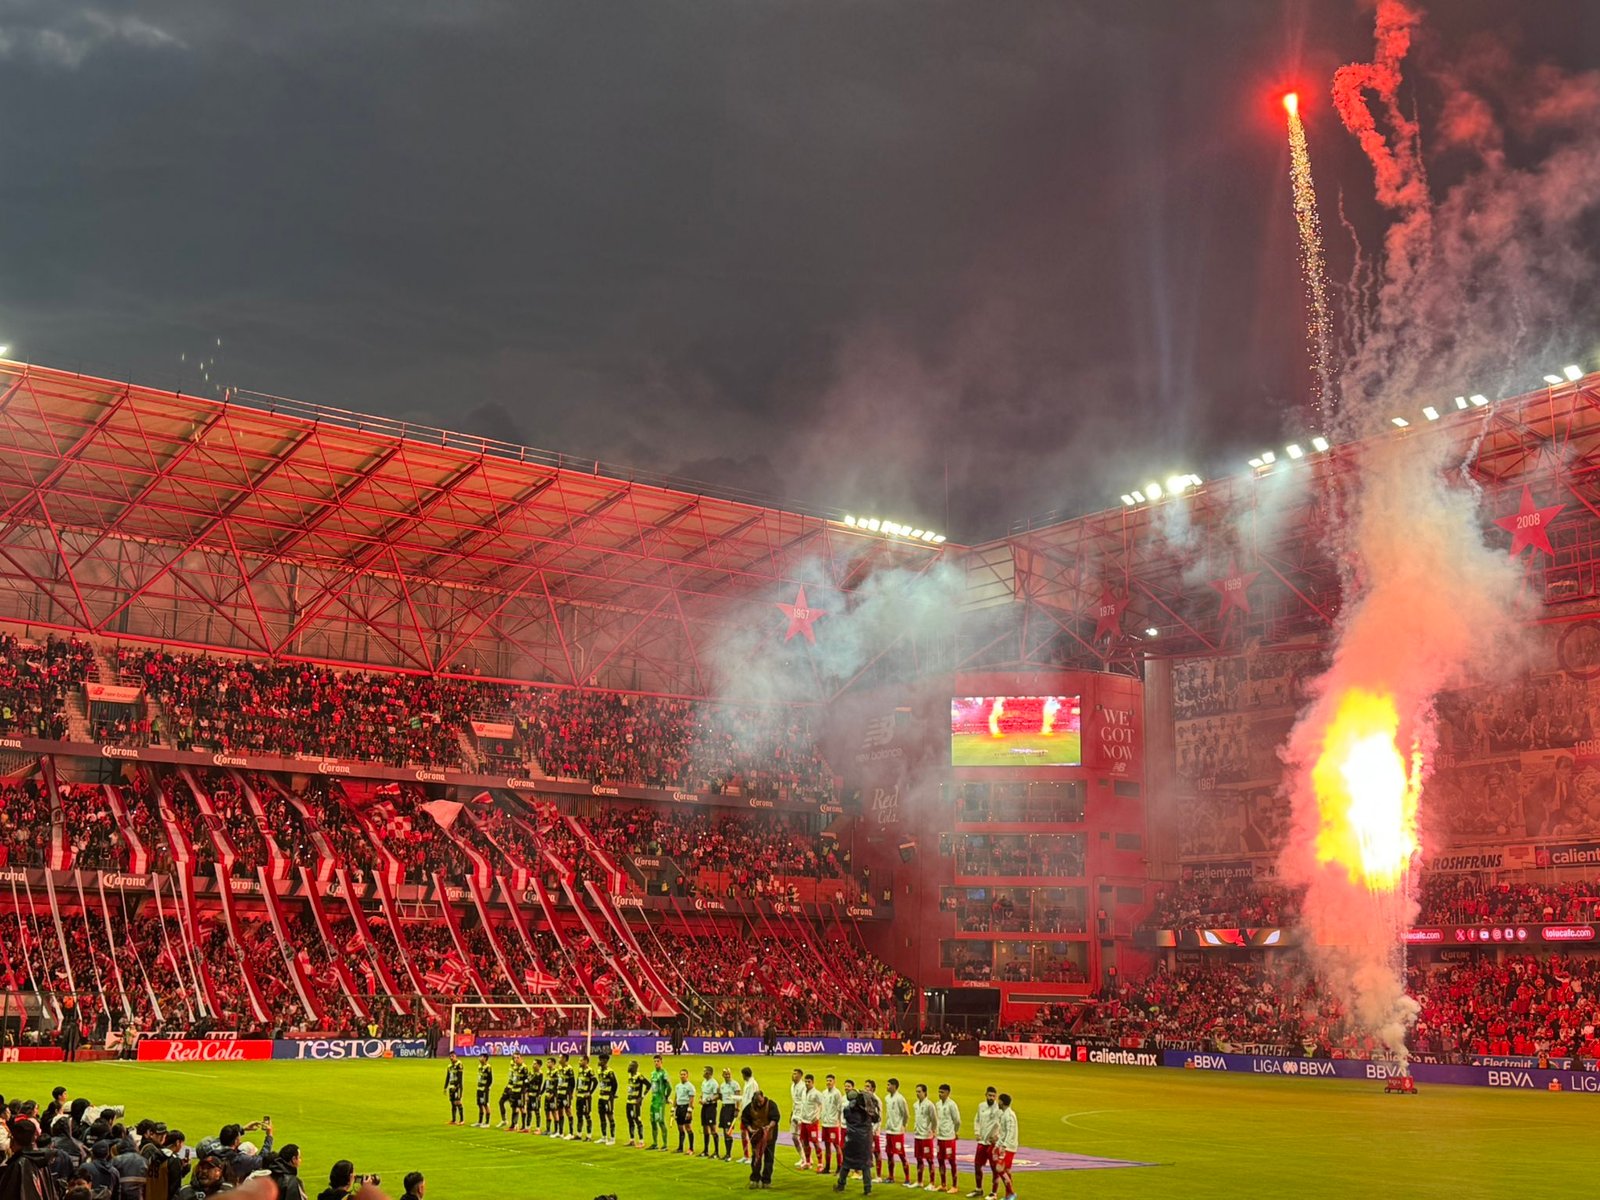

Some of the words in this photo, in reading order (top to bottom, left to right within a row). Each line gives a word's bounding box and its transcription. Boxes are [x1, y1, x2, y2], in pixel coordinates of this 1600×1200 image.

[1516, 512, 1541, 529] 2008
[1103, 708, 1130, 726] WE
[1100, 726, 1135, 744] GOT
[101, 744, 139, 758] Corona
[1102, 744, 1135, 760] NOW
[1574, 739, 1600, 756] 1998
[213, 753, 247, 766] Corona
[318, 762, 351, 774] Corona
[415, 770, 446, 781] Corona
[506, 777, 535, 789] Corona
[592, 784, 619, 795] Corona
[673, 791, 698, 802] Corona
[749, 798, 774, 808] Corona
[871, 784, 899, 810] Red
[820, 803, 843, 813] Corona
[634, 855, 660, 867] Corona
[1432, 854, 1503, 871] ROSHFRANS
[1193, 866, 1252, 880] caliente.mx
[103, 873, 147, 888] Corona
[846, 906, 873, 917] Corona
[1545, 926, 1592, 938] tolucafc.com
[165, 1040, 203, 1061] Red
[203, 1041, 247, 1061] Cola
[550, 1041, 579, 1054] LIGA
[655, 1041, 690, 1053] BBA
[702, 1041, 735, 1053] BBVA
[796, 1042, 825, 1053] BBVA
[846, 1043, 875, 1054] BBVA
[1089, 1050, 1158, 1067] caliente.mx
[1194, 1054, 1228, 1071] BBVA
[1253, 1059, 1282, 1074] LIGA
[1300, 1061, 1337, 1076] BBVA
[1488, 1070, 1535, 1088] BBVA
